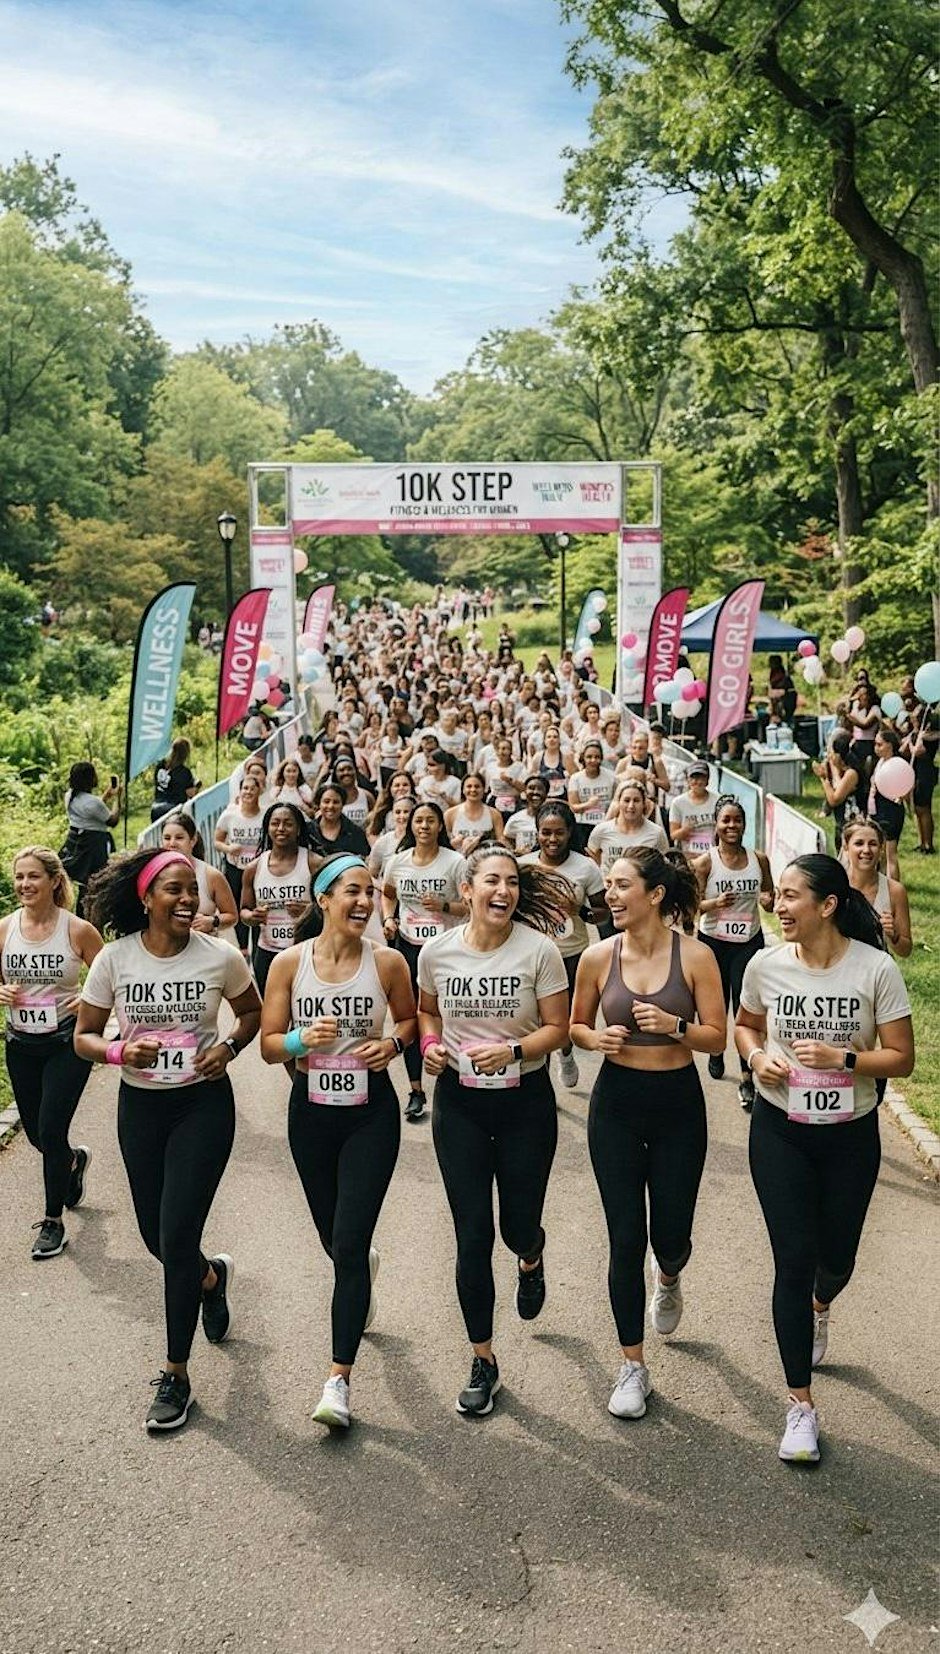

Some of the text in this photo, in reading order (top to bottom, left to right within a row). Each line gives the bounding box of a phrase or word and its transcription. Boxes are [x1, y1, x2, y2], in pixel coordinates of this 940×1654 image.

[396, 472, 443, 501] 10K
[452, 472, 513, 501] STEP
[227, 620, 258, 696] MOVE
[717, 602, 750, 708] GO GIRLS
[138, 607, 180, 741] WELLNESS
[258, 887, 276, 899] 10K
[726, 922, 747, 935] 102
[125, 981, 206, 1002] 10K STEP
[445, 976, 521, 996] 10K STEP
[296, 996, 374, 1018] 10K STEP
[774, 994, 860, 1018] 10K STEP
[802, 1091, 841, 1111] 102
